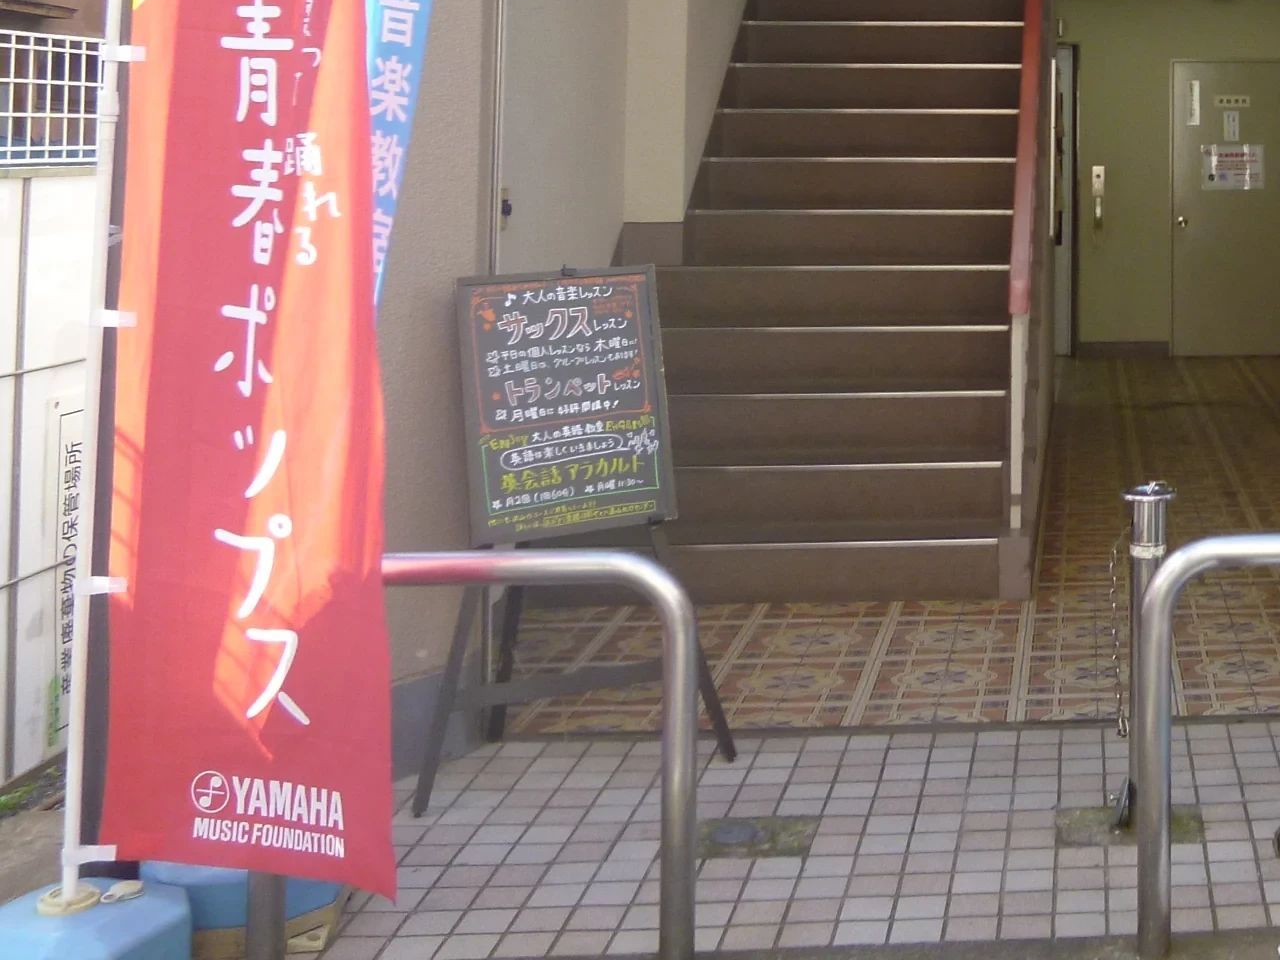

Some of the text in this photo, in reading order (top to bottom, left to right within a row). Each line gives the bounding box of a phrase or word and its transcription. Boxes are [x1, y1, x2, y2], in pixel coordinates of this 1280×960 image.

[522, 286, 613, 305] 大人の音楽レッスン
[497, 306, 593, 346] サックス
[504, 373, 612, 407] トランペット
[232, 775, 345, 831] YAMAHA
[192, 817, 346, 858] MUSIC FOUNDATION
